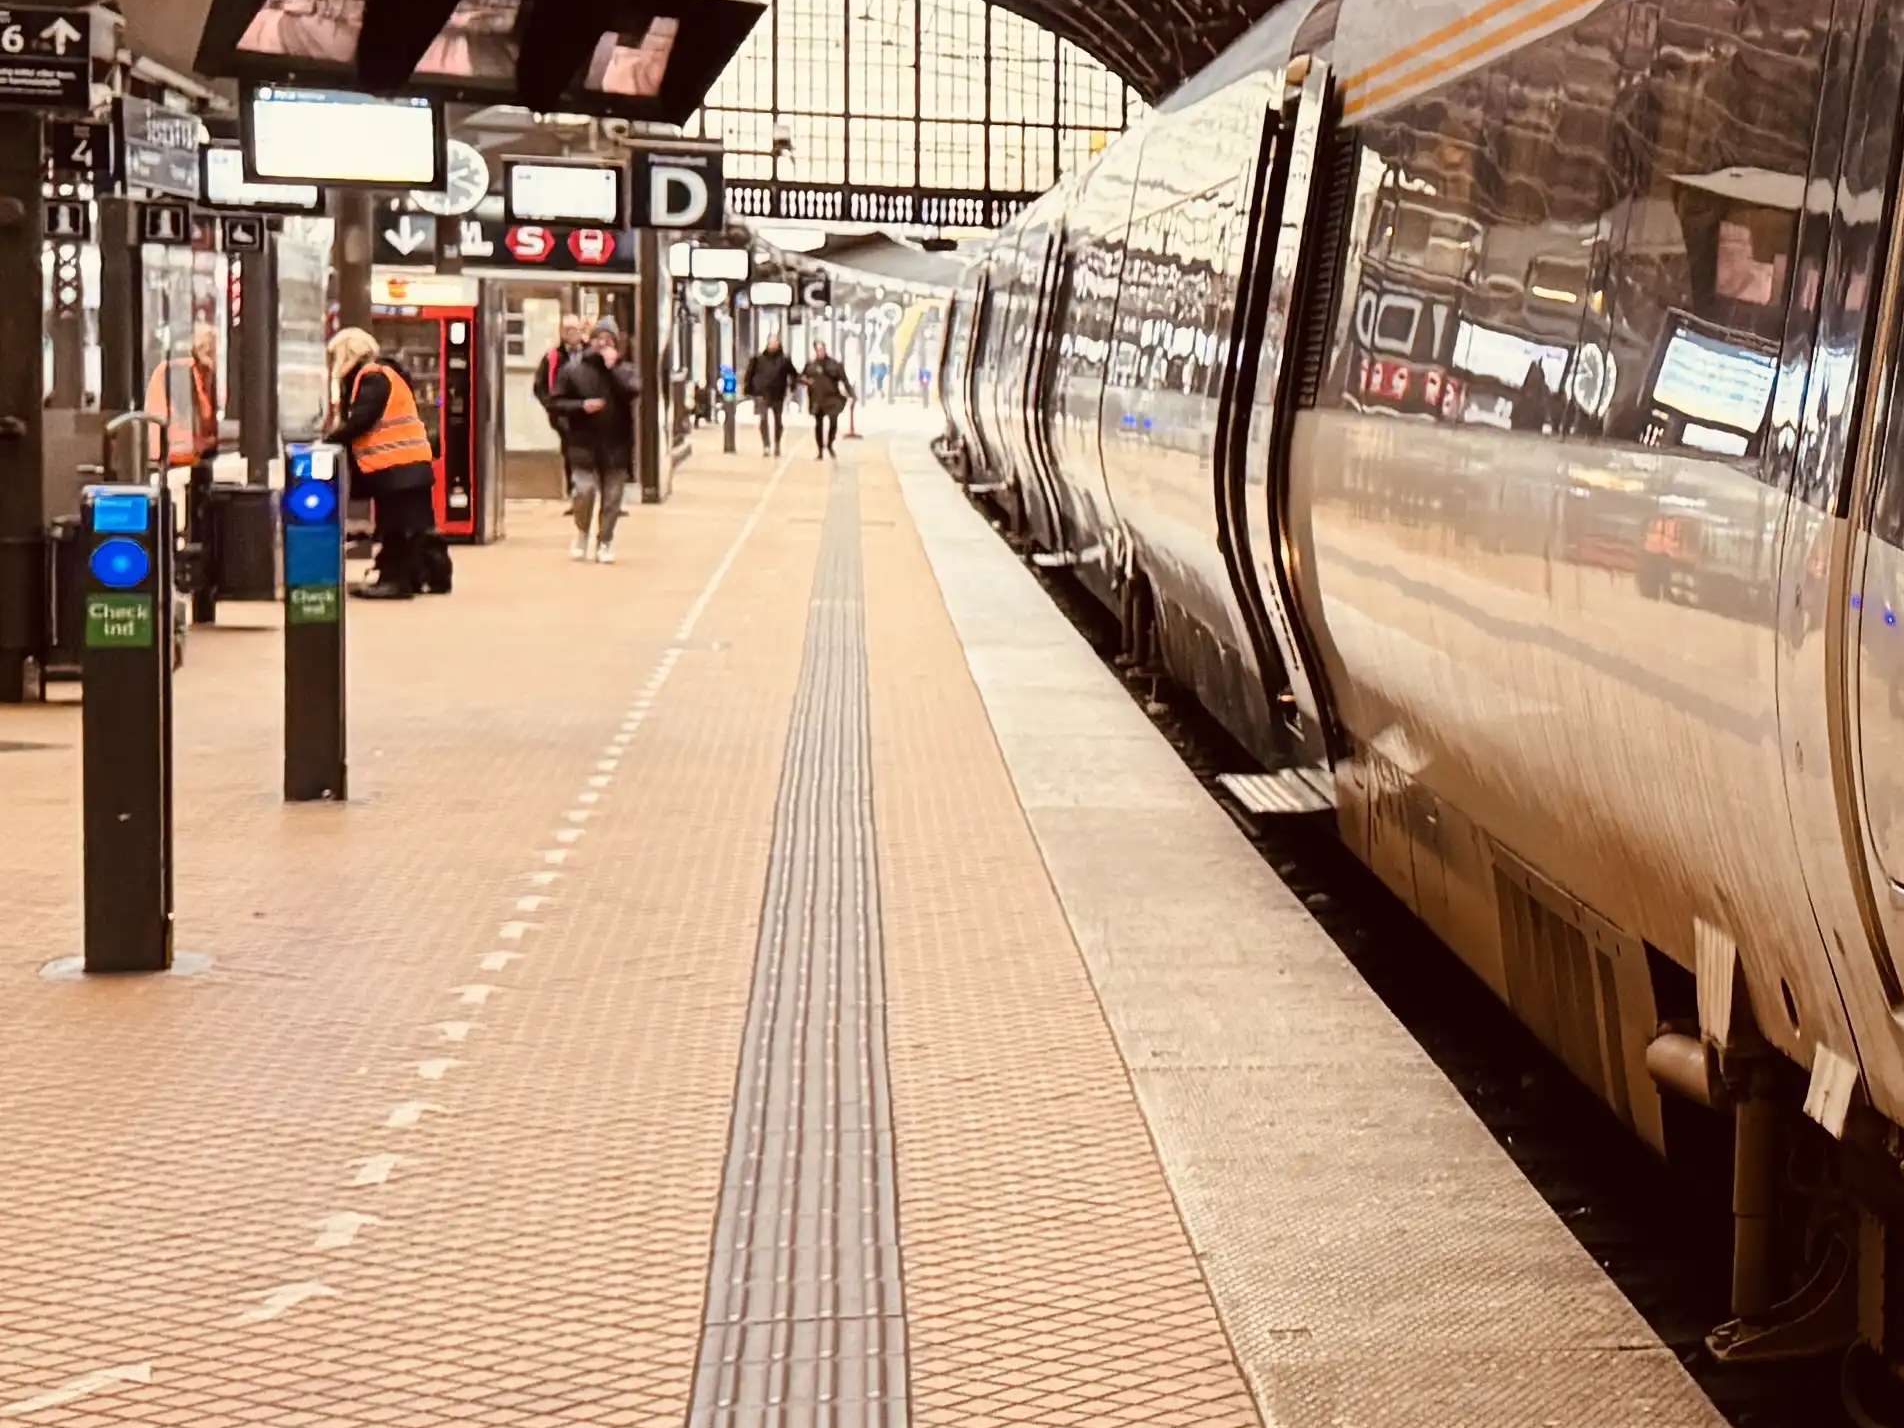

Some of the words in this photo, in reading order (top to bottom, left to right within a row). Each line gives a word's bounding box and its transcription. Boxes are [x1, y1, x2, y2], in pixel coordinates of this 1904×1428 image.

[650, 166, 708, 227] D
[292, 590, 334, 603] Check
[88, 602, 148, 620] Check
[104, 620, 135, 637] ind
